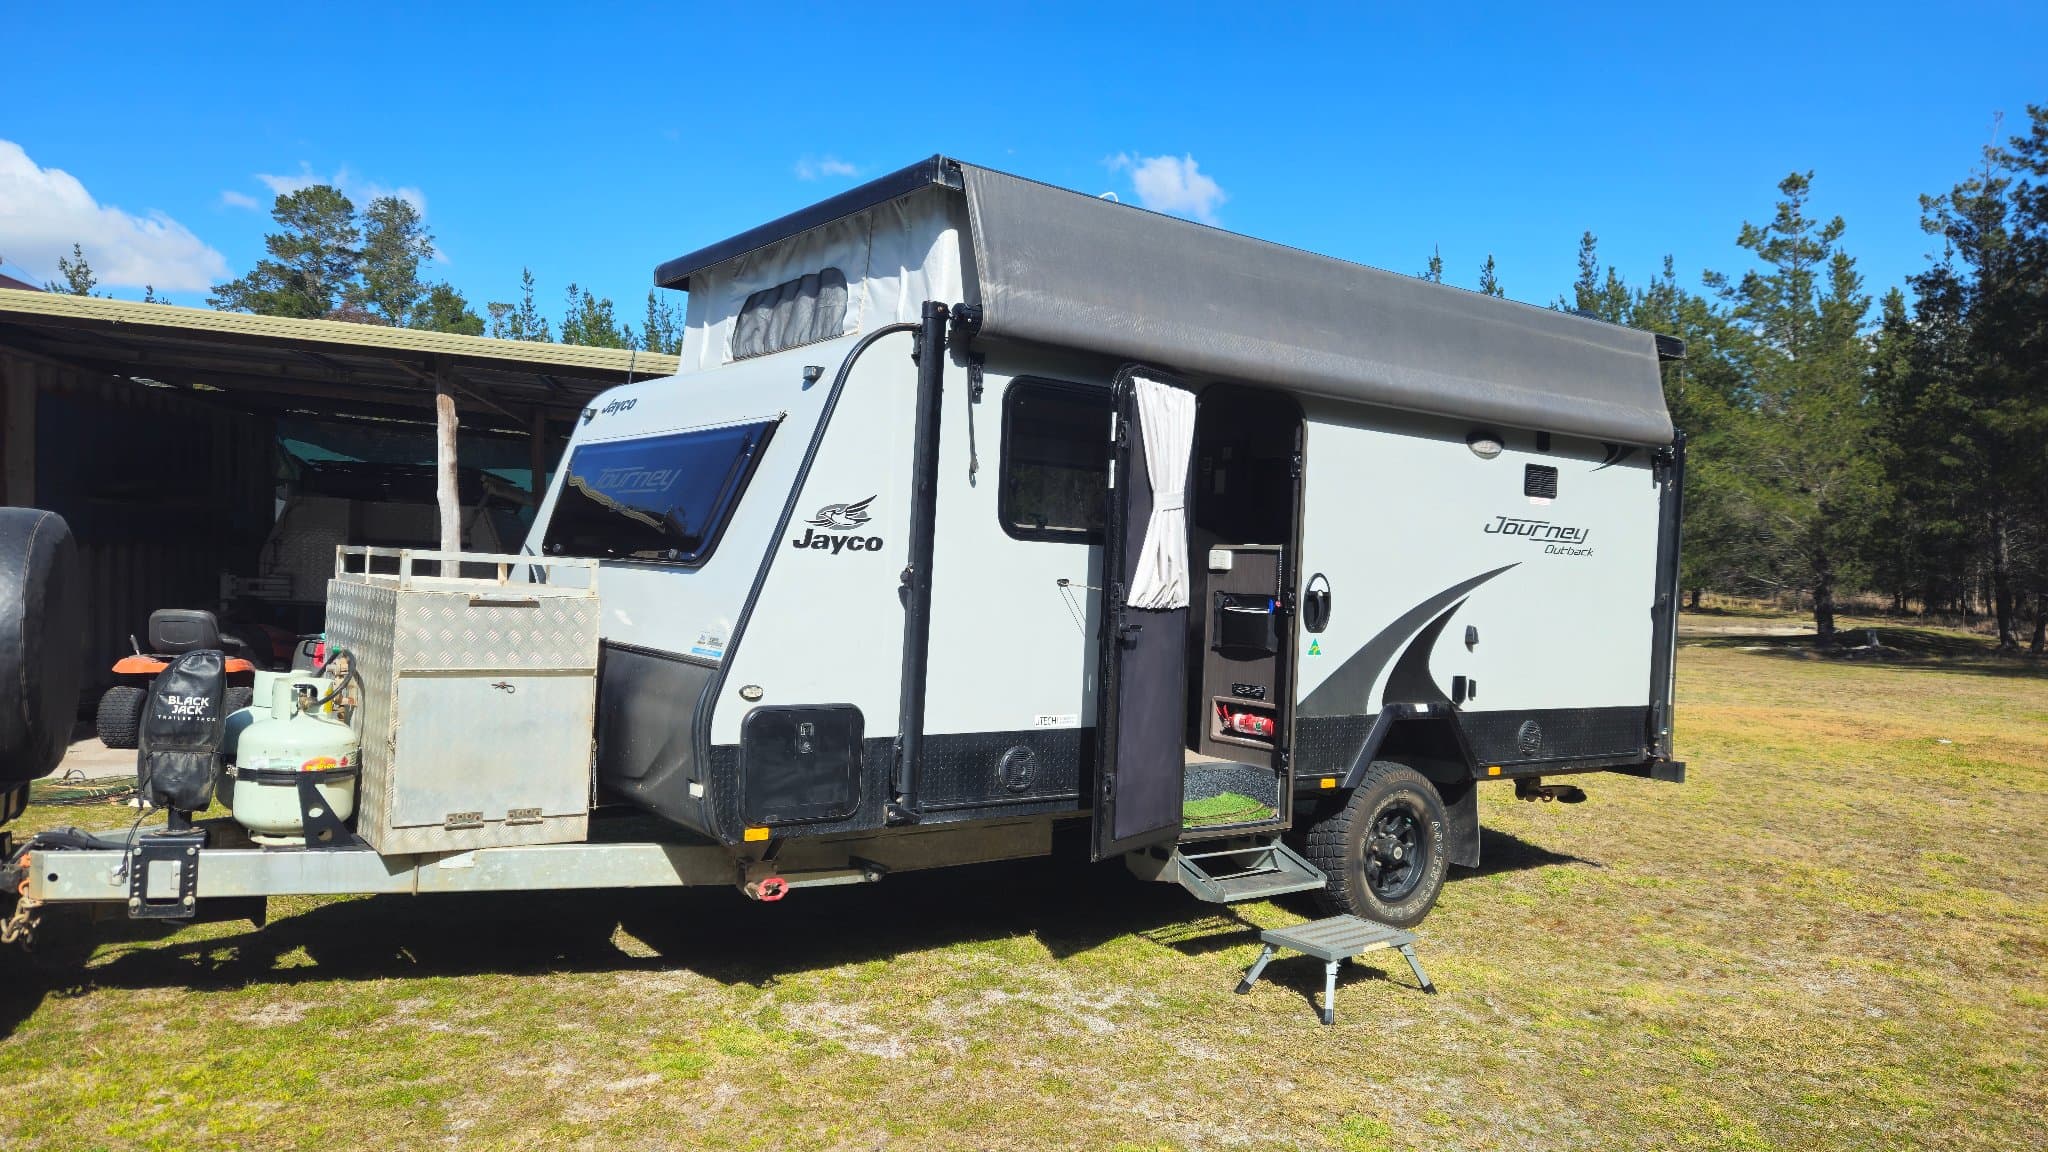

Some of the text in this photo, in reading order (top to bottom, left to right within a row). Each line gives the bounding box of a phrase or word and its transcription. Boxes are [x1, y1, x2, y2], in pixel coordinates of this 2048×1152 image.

[602, 398, 638, 416] Jayco
[594, 466, 682, 493] Journey
[1484, 515, 1589, 544] Journey
[792, 528, 884, 555] Jayco
[1544, 544, 1594, 557] Outback
[168, 696, 209, 706] BLACK
[171, 705, 203, 714] JACK
